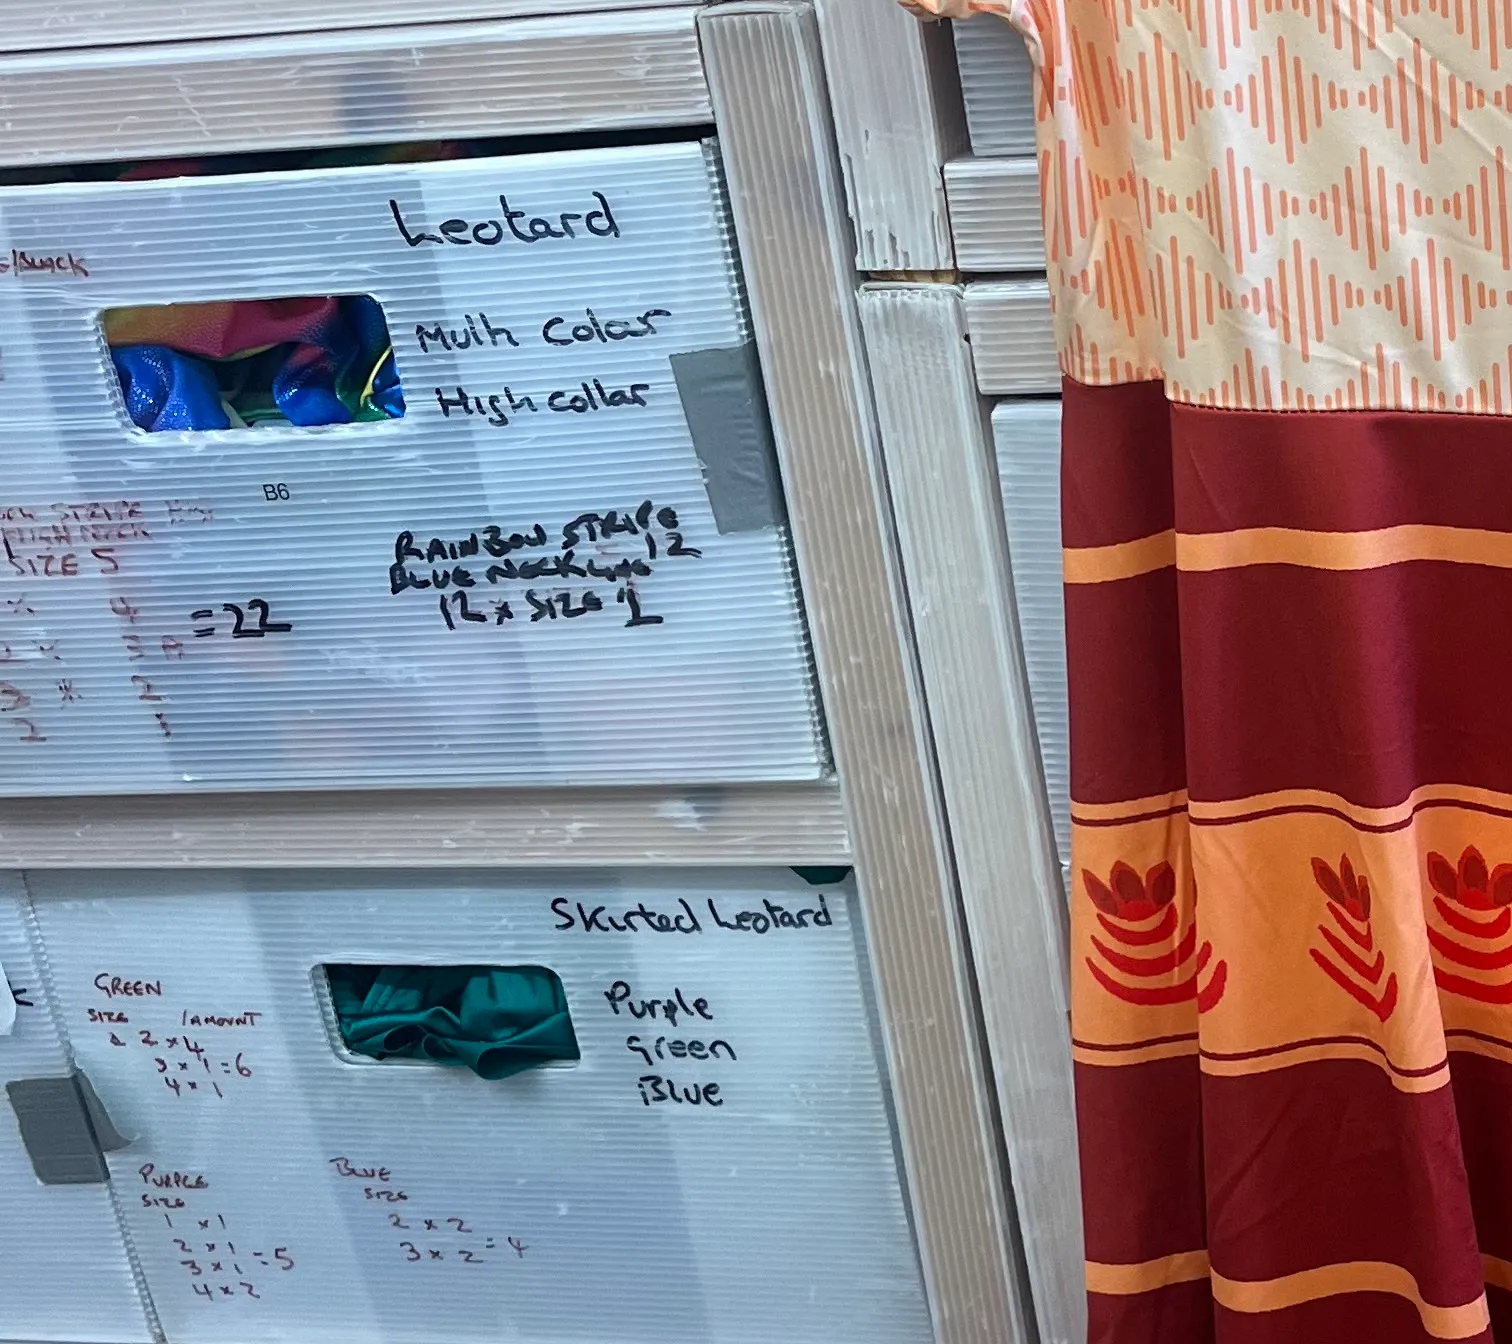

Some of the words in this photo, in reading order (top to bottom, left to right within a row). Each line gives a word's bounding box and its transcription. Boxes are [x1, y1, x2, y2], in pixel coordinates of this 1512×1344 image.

[388, 190, 621, 248] Leotard
[435, 386, 539, 428] High
[262, 482, 291, 502] B6
[551, 897, 703, 935] Skirted
[707, 893, 834, 935] Leotard
[94, 972, 163, 1000] GREEN
[604, 980, 714, 1028] Purple
